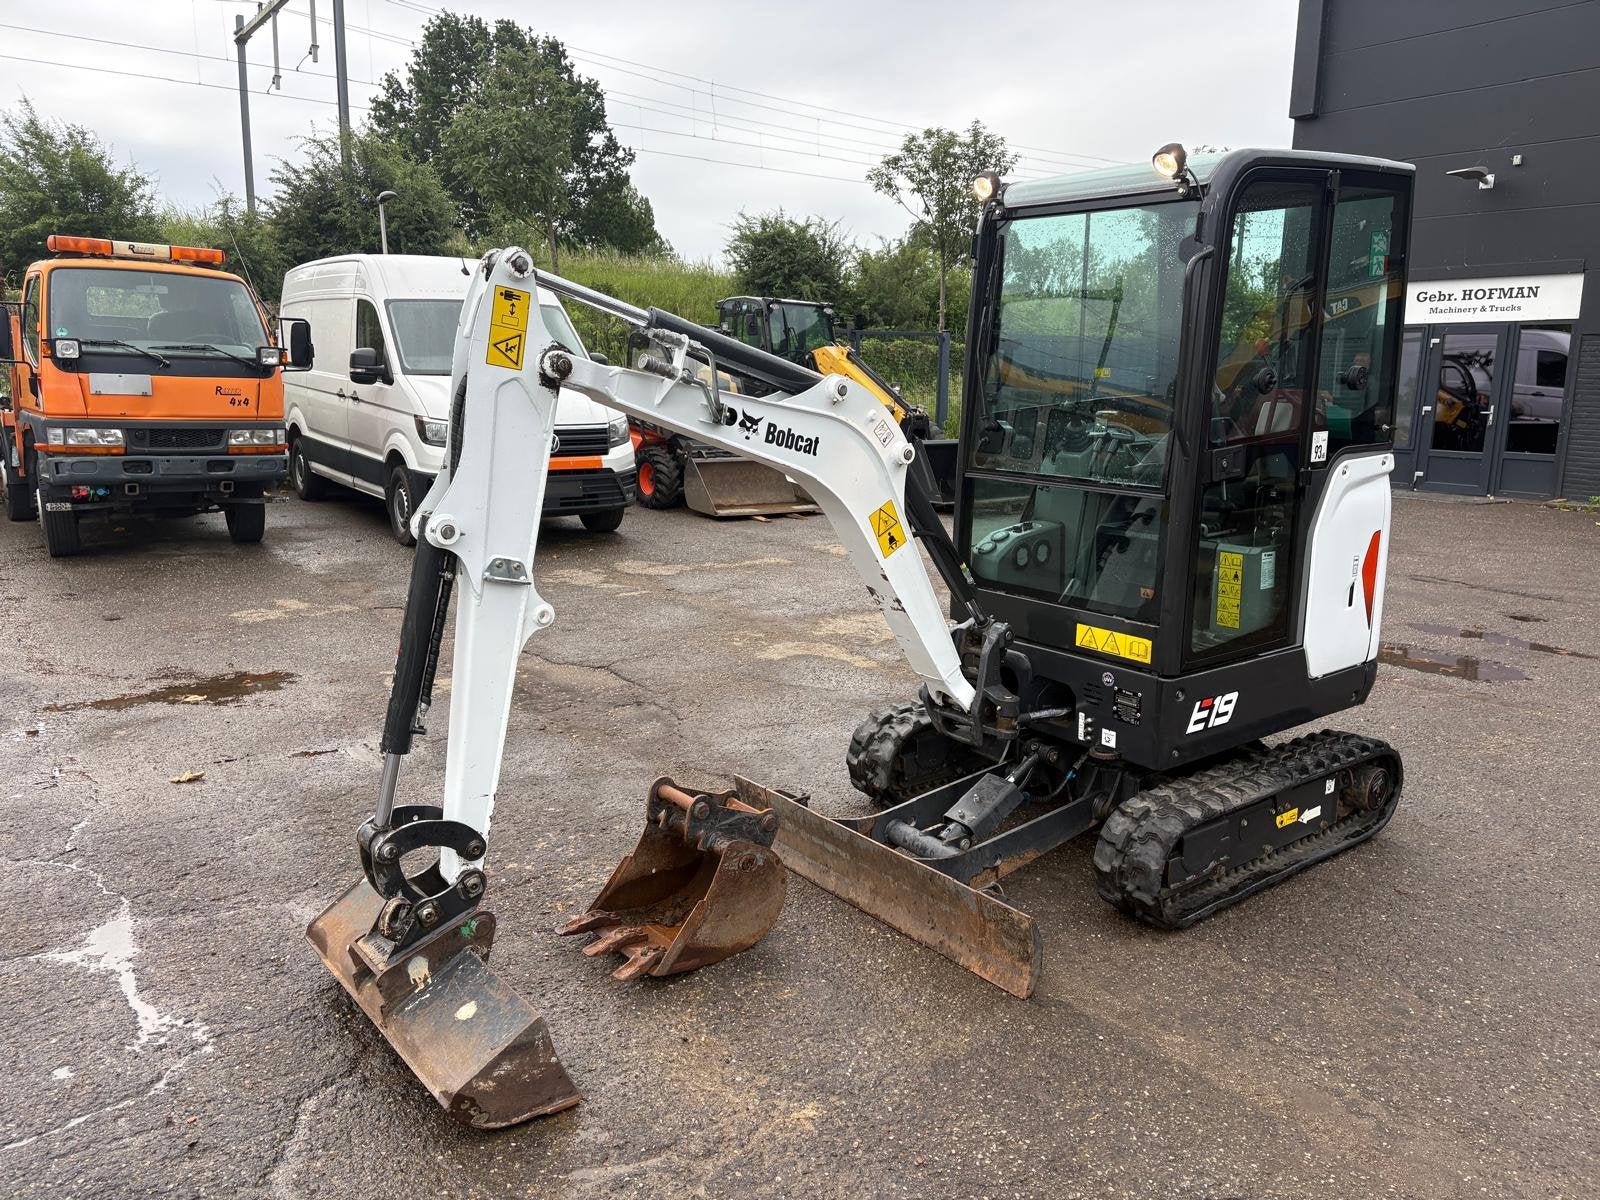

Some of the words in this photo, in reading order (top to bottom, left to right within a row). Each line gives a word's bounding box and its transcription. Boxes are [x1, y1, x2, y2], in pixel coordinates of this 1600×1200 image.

[1416, 291, 1458, 303] Gebr.
[1461, 286, 1540, 301] HOFMAN
[1429, 307, 1478, 315] Machinery
[1480, 305, 1487, 313] &
[1489, 304, 1522, 312] Trucks
[229, 397, 249, 406] 4x4
[764, 422, 820, 456] Bobcat
[1314, 445, 1322, 460] 93
[1185, 691, 1239, 735] E19
